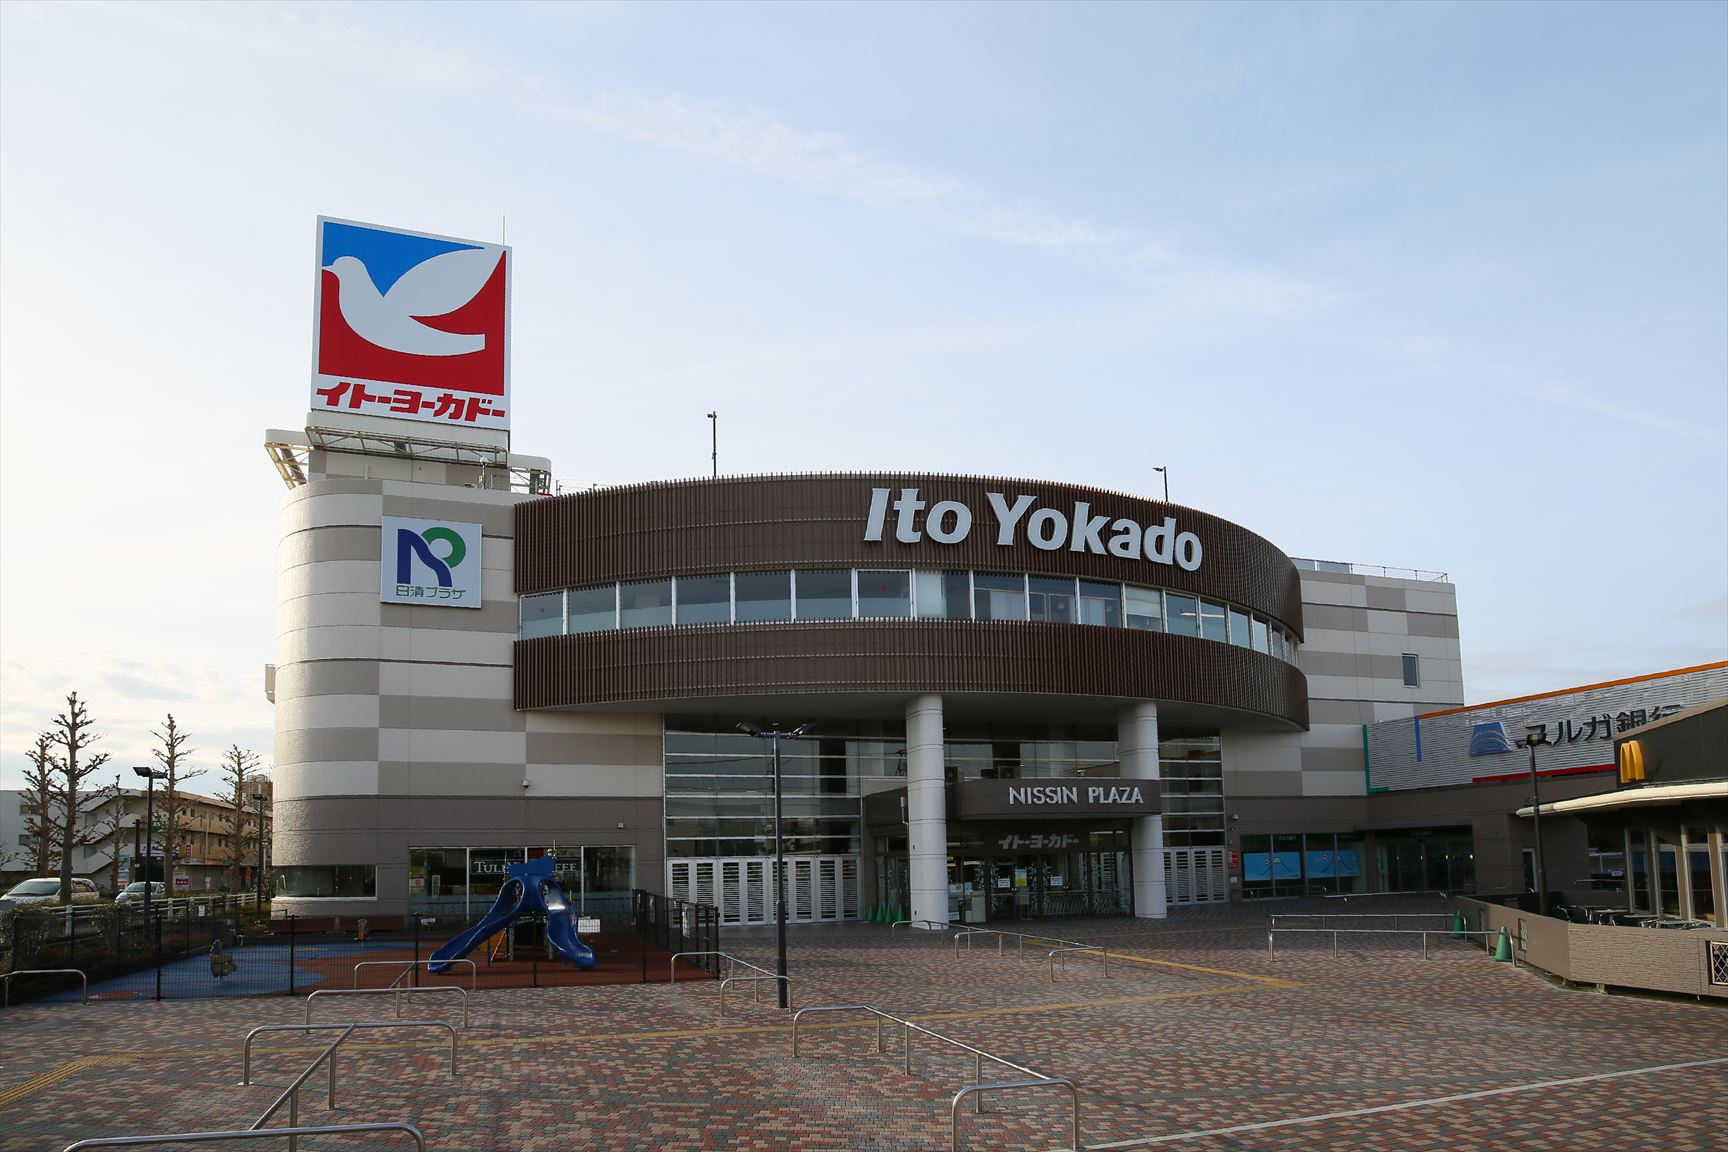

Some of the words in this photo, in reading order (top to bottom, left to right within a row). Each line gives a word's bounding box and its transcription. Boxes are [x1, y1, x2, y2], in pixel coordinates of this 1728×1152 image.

[316, 381, 506, 422] イトーヨーカドー
[863, 487, 973, 544] Ito
[986, 492, 1203, 571] Yokado
[396, 585, 467, 600] 日清プラザ
[1009, 786, 1079, 805] NISSIN
[1088, 786, 1145, 804] PLAZA
[998, 834, 1079, 849] イトーヨーカドー
